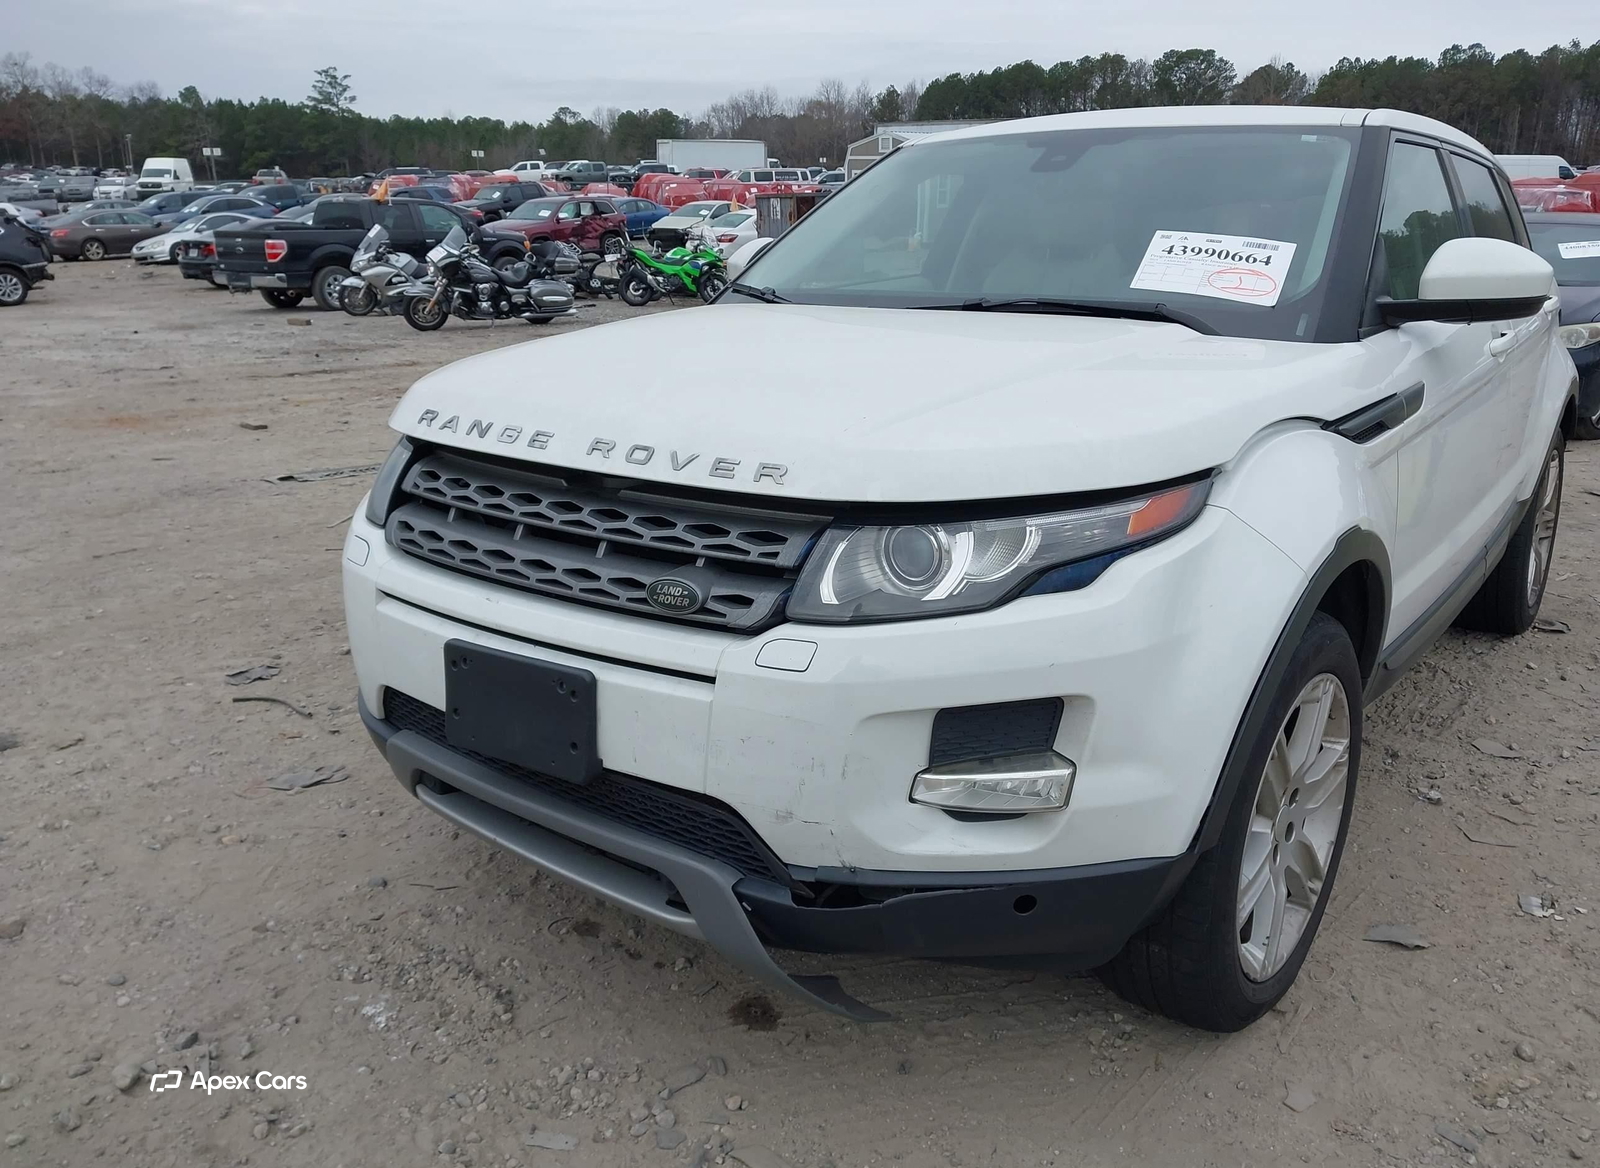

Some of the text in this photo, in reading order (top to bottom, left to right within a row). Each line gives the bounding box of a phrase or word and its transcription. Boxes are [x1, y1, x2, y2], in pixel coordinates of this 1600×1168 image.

[1161, 244, 1272, 266] 43990664
[418, 408, 788, 485] RANGE ROVER
[657, 594, 690, 607] ROVER
